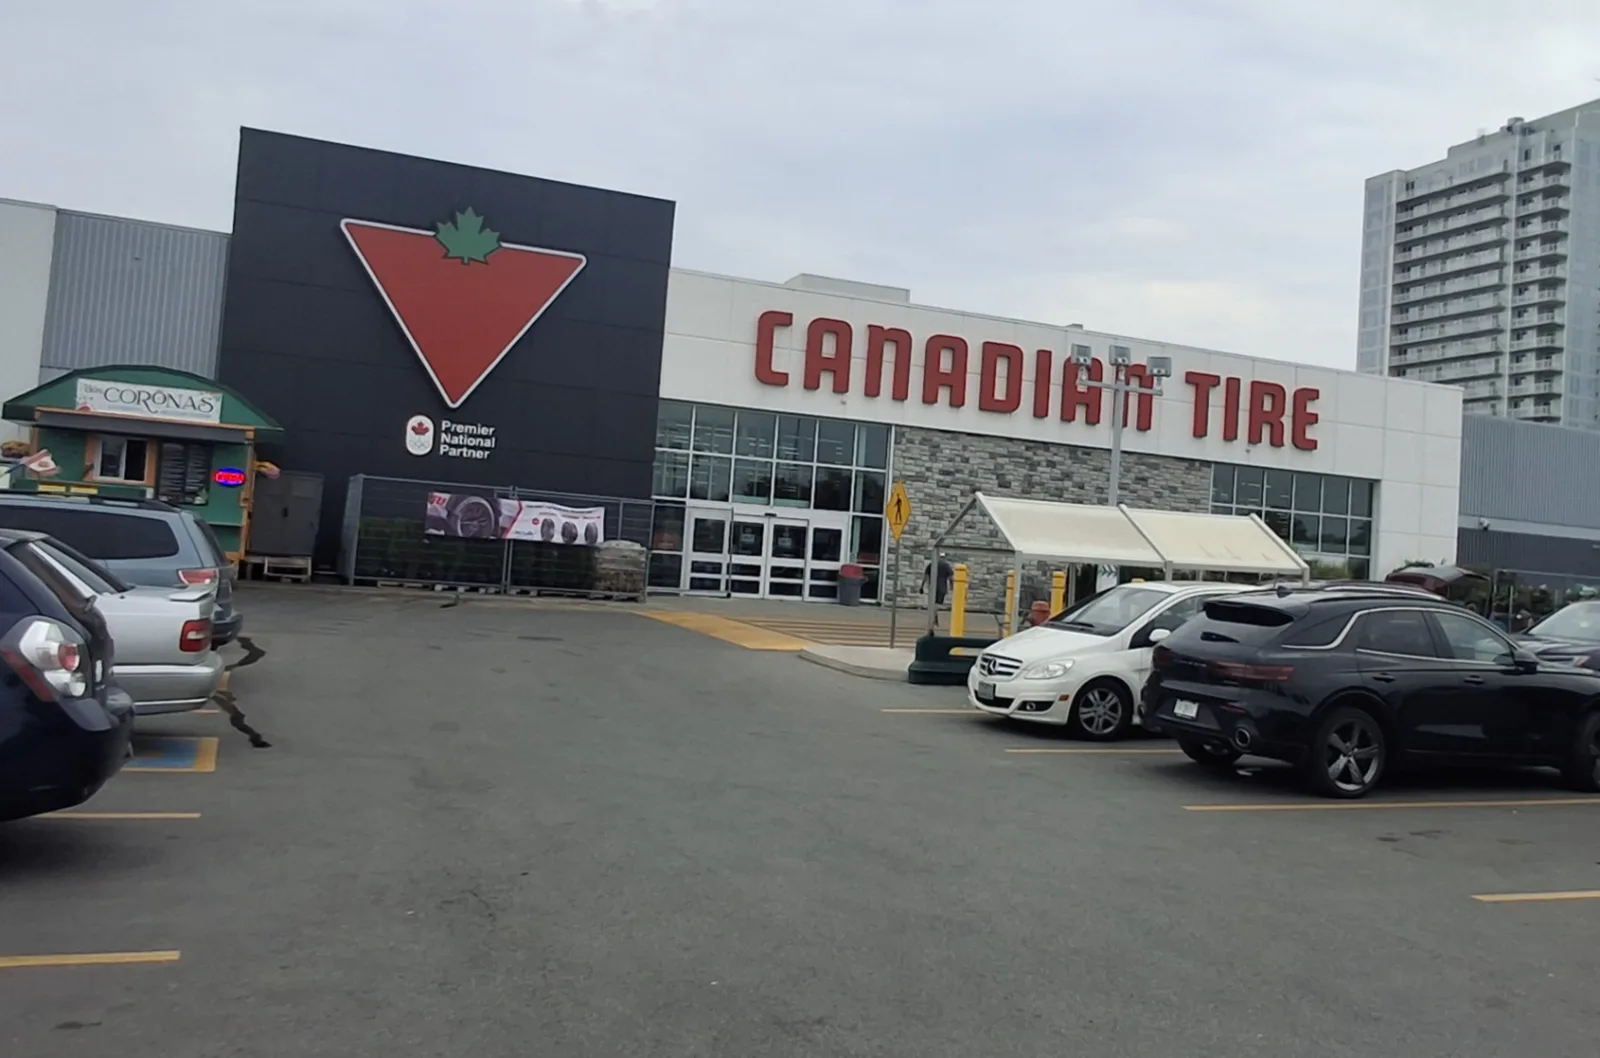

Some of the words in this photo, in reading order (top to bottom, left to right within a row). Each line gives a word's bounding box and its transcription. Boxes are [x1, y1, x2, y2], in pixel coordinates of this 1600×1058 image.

[754, 310, 1154, 432] CANADIAN
[1184, 370, 1320, 450] TIRE
[441, 420, 495, 436] Premier
[440, 432, 495, 448] National
[440, 444, 490, 459] Partner
